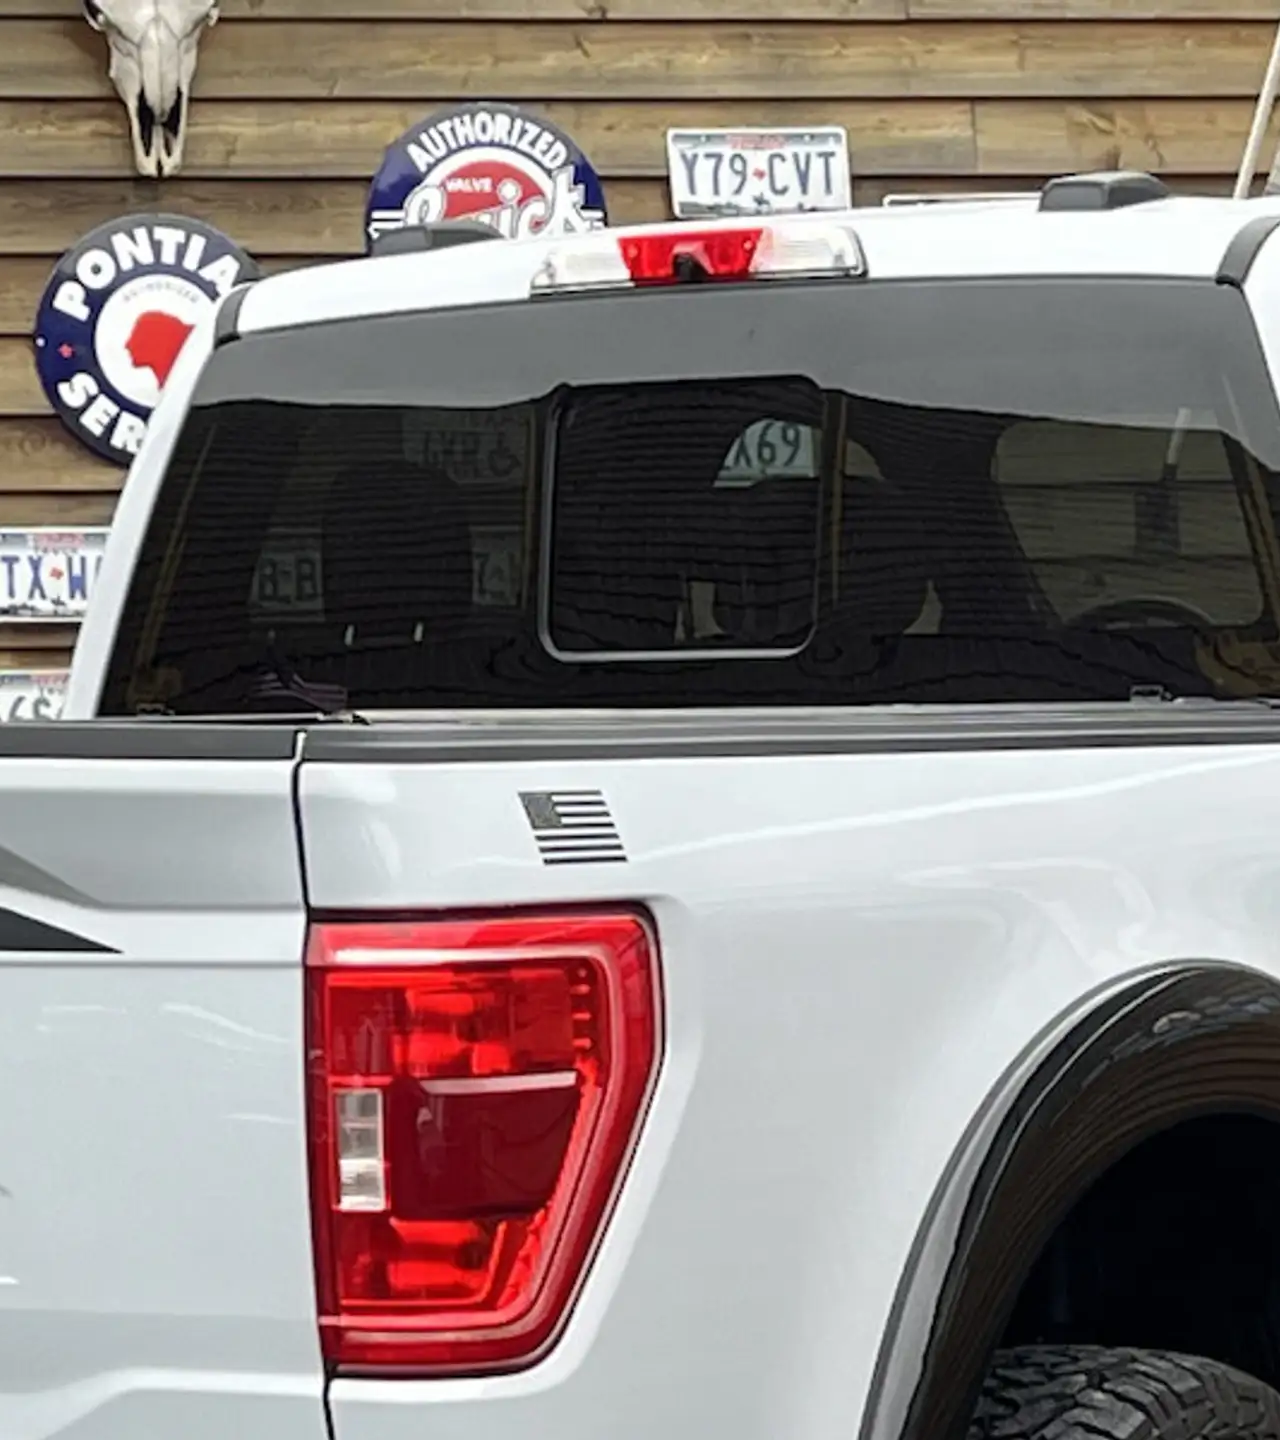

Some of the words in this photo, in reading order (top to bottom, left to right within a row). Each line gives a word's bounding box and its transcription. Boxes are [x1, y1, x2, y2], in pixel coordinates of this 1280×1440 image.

[407, 111, 567, 172] AUTHORIZED
[680, 152, 747, 196] Y79
[768, 151, 836, 196] CVT
[53, 226, 241, 321] PONTIA
[66, 555, 104, 601] W
